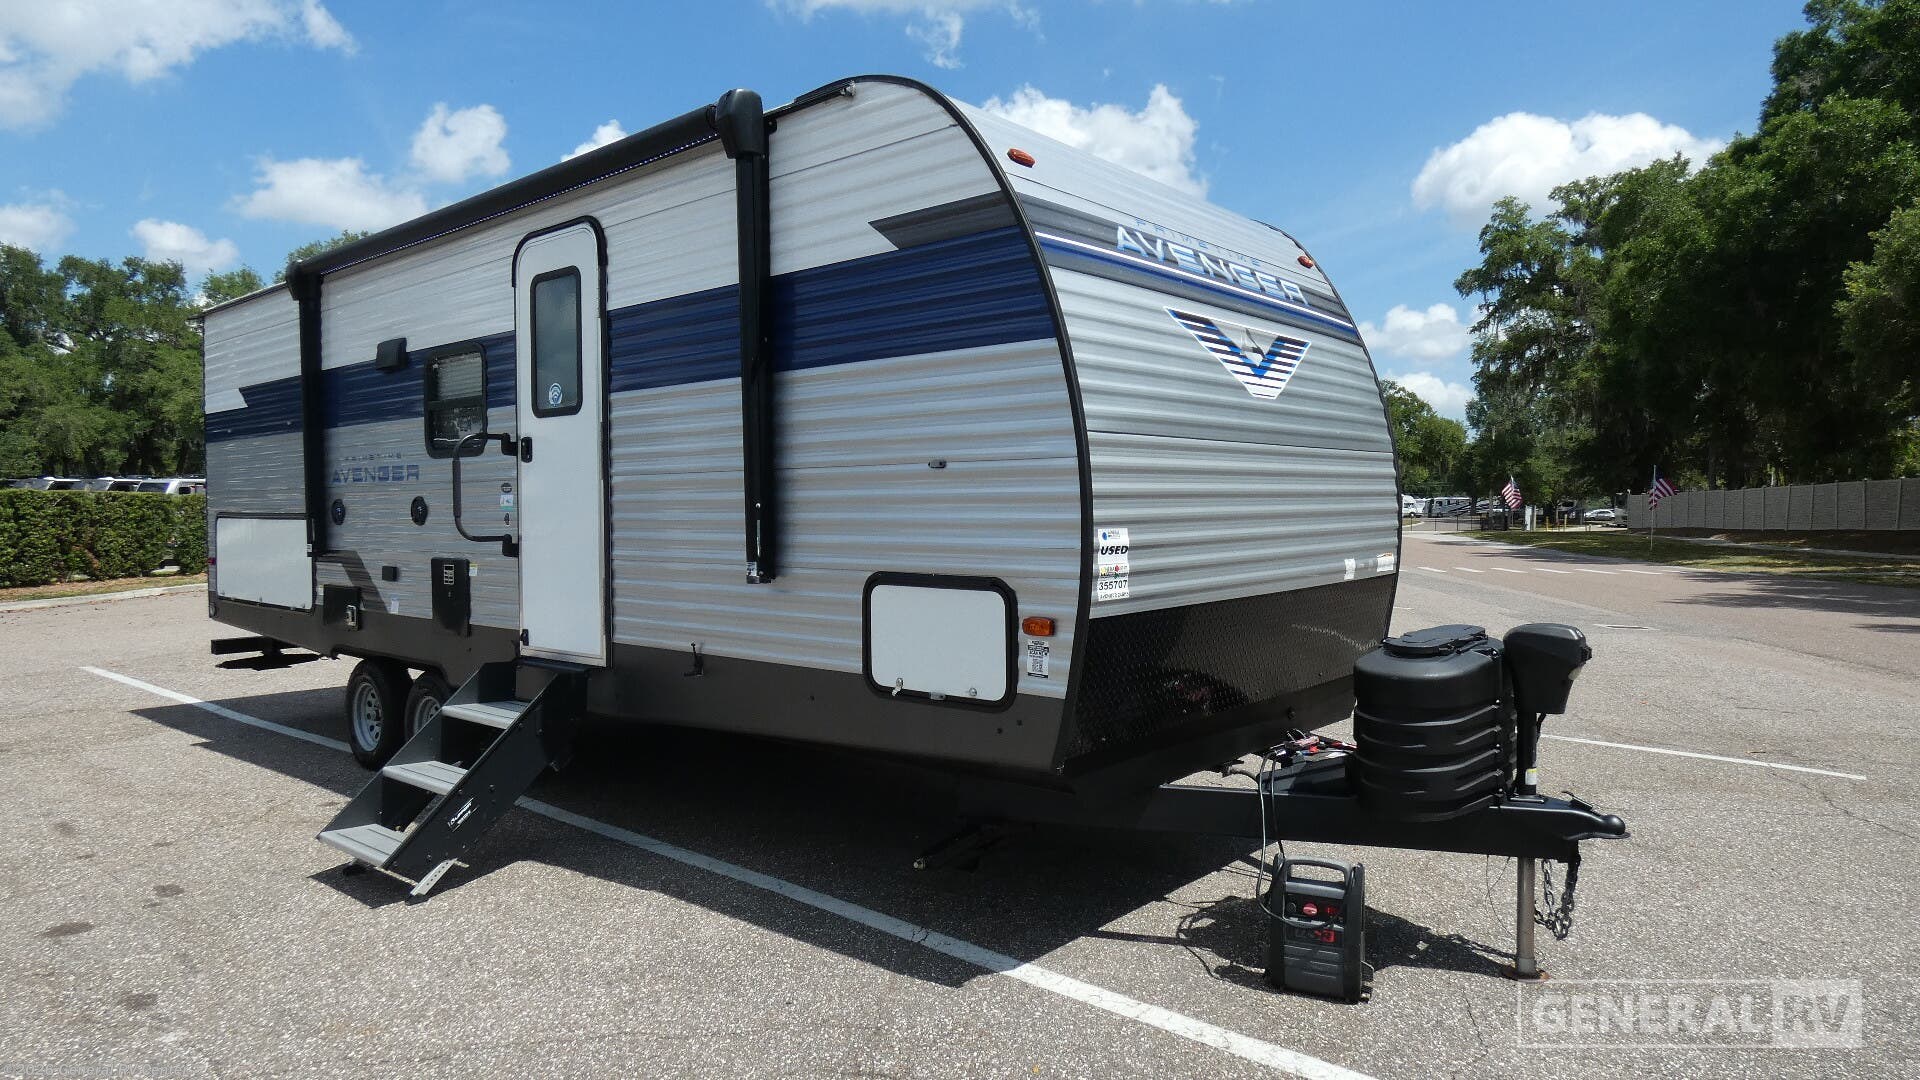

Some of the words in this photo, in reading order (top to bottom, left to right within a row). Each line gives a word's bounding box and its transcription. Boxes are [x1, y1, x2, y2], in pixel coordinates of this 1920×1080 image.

[1117, 225, 1309, 307] AVENGER
[332, 464, 419, 483] AVENGER
[1101, 545, 1129, 555] USED
[1099, 579, 1128, 591] 355707
